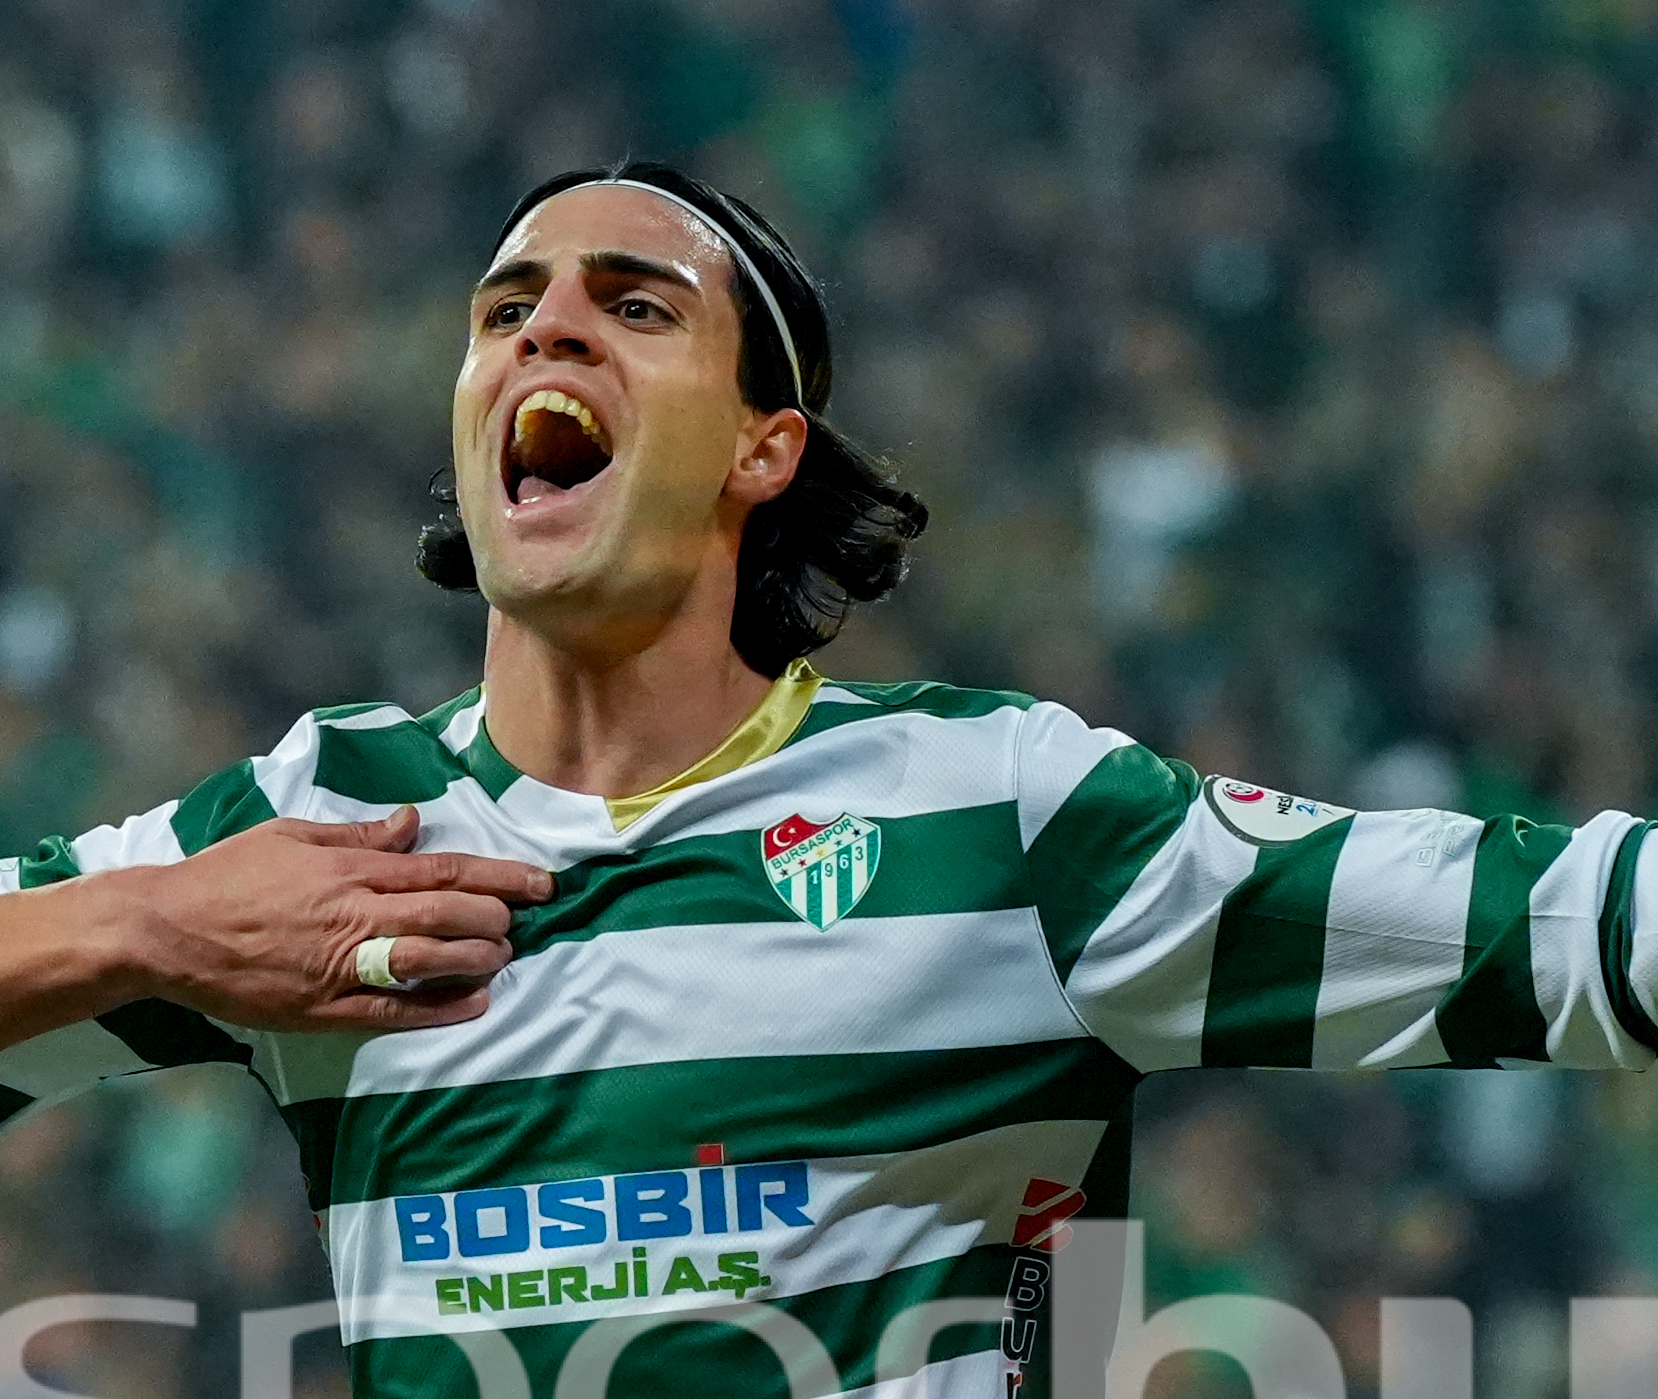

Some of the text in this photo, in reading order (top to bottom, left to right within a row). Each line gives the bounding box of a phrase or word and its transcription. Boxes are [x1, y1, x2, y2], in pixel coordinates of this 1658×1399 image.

[771, 818, 855, 869] BURSASPOR
[808, 846, 864, 885] 1963
[393, 1144, 816, 1263] BOSBİR
[435, 1247, 772, 1316] ENERJİ A.Ş.
